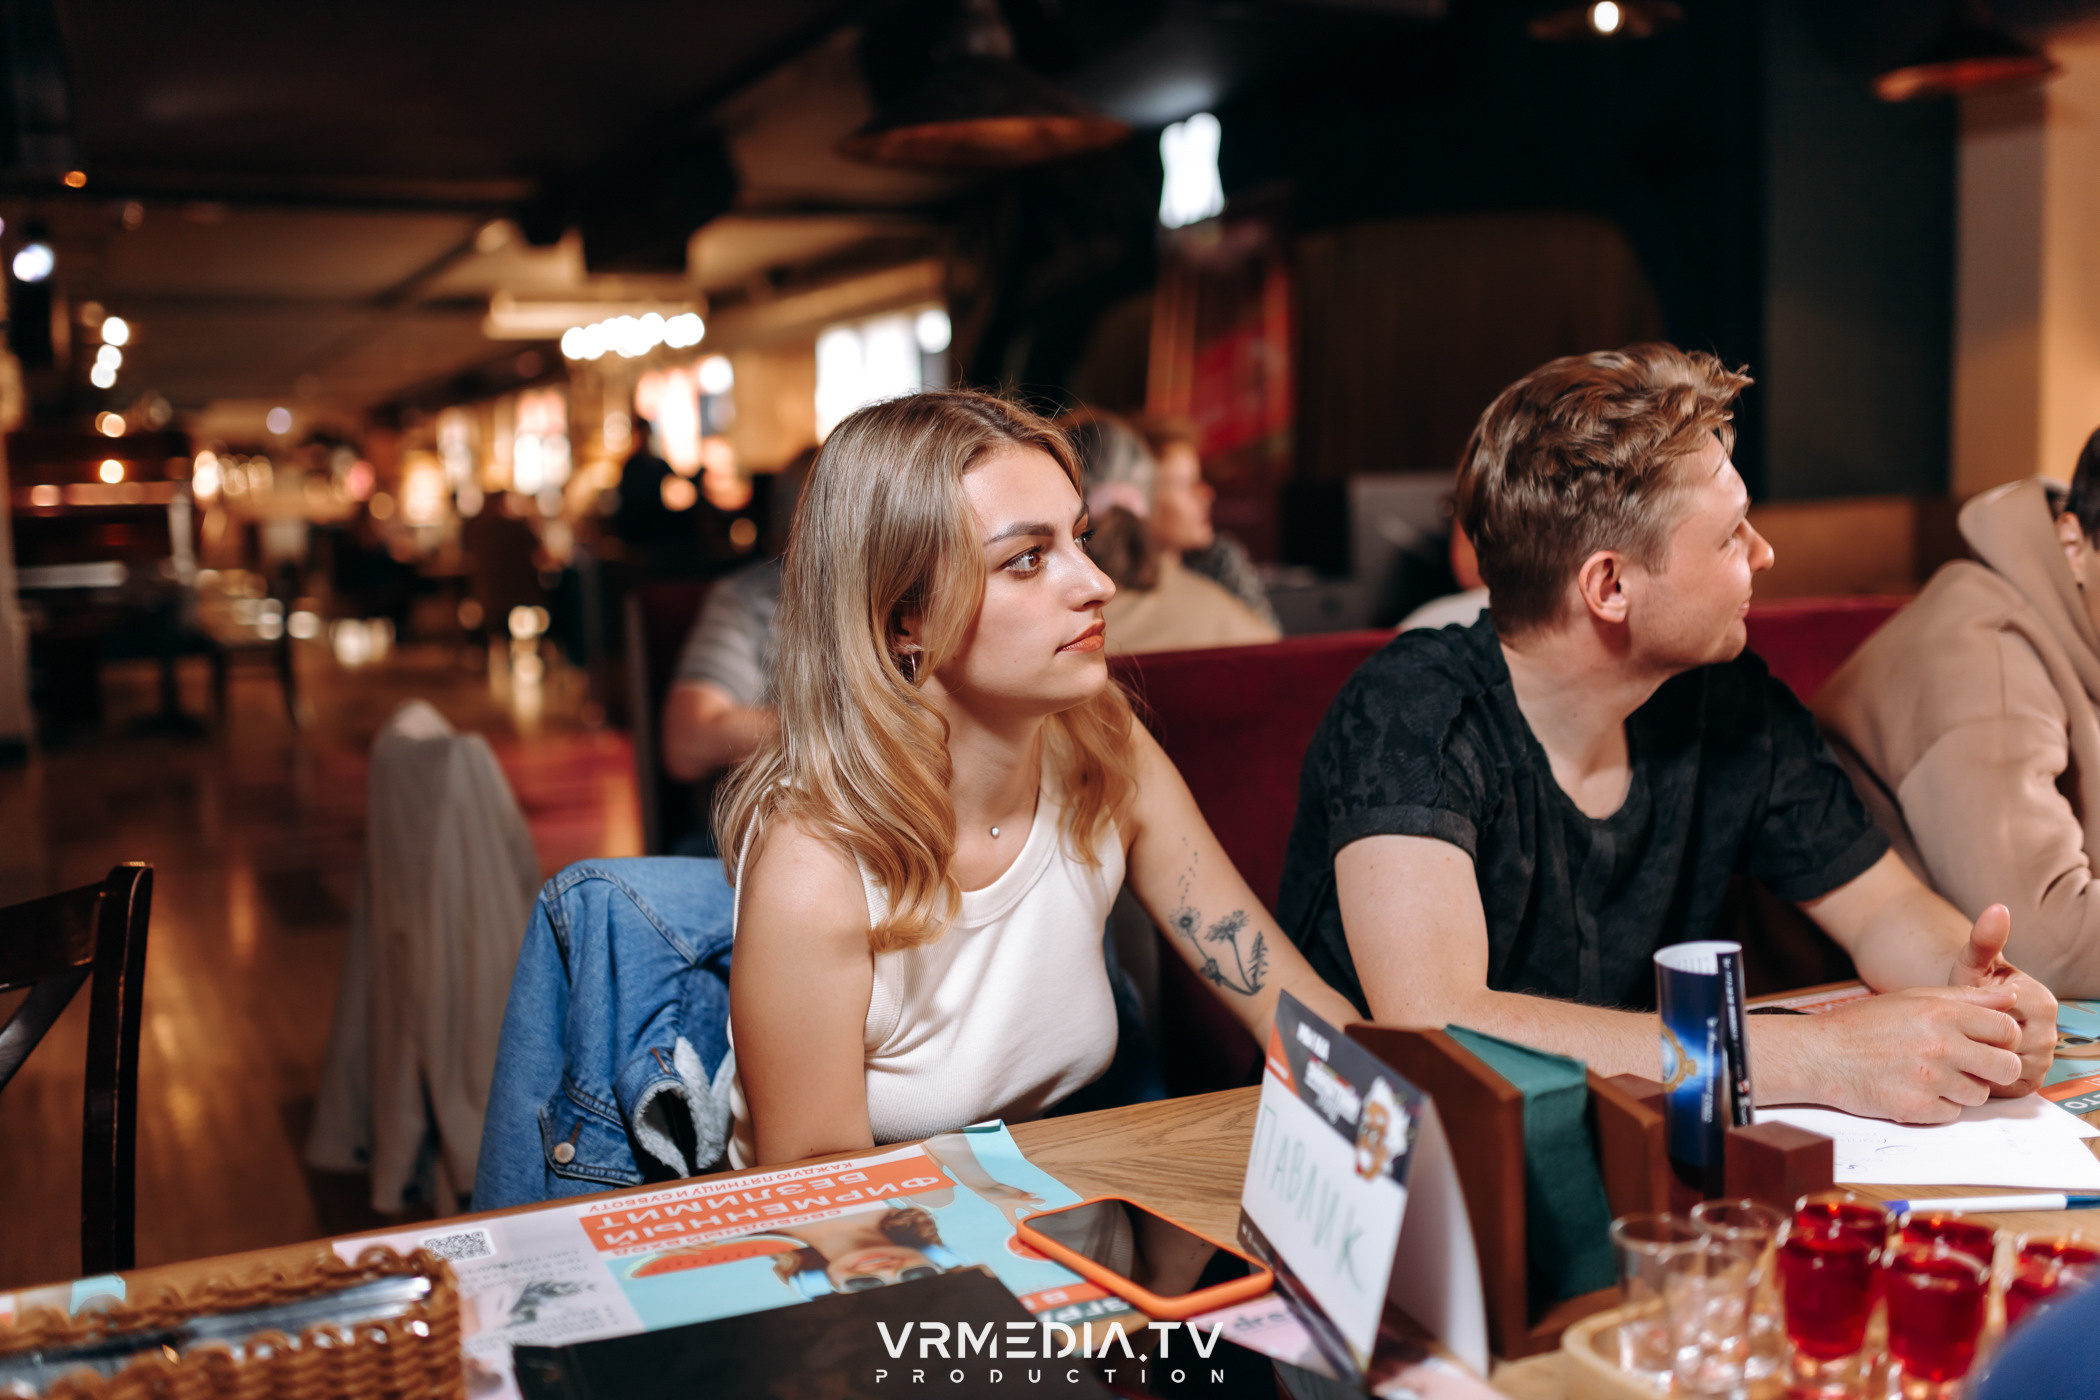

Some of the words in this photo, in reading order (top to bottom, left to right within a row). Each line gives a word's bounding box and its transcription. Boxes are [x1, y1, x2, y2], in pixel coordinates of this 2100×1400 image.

[776, 1162, 852, 1180] КАЖДУЮ
[676, 1189, 689, 1199] И
[692, 1174, 774, 1196] ПЯТНИЦУ
[589, 1191, 673, 1213] СУББОТУ
[596, 1171, 869, 1230] БЕЗЛИМИТ
[603, 1176, 940, 1247] ФИРМЕННЫЙ
[685, 1209, 842, 1245] СВОБОДНЫЙ
[612, 1237, 681, 1257] ВХОД
